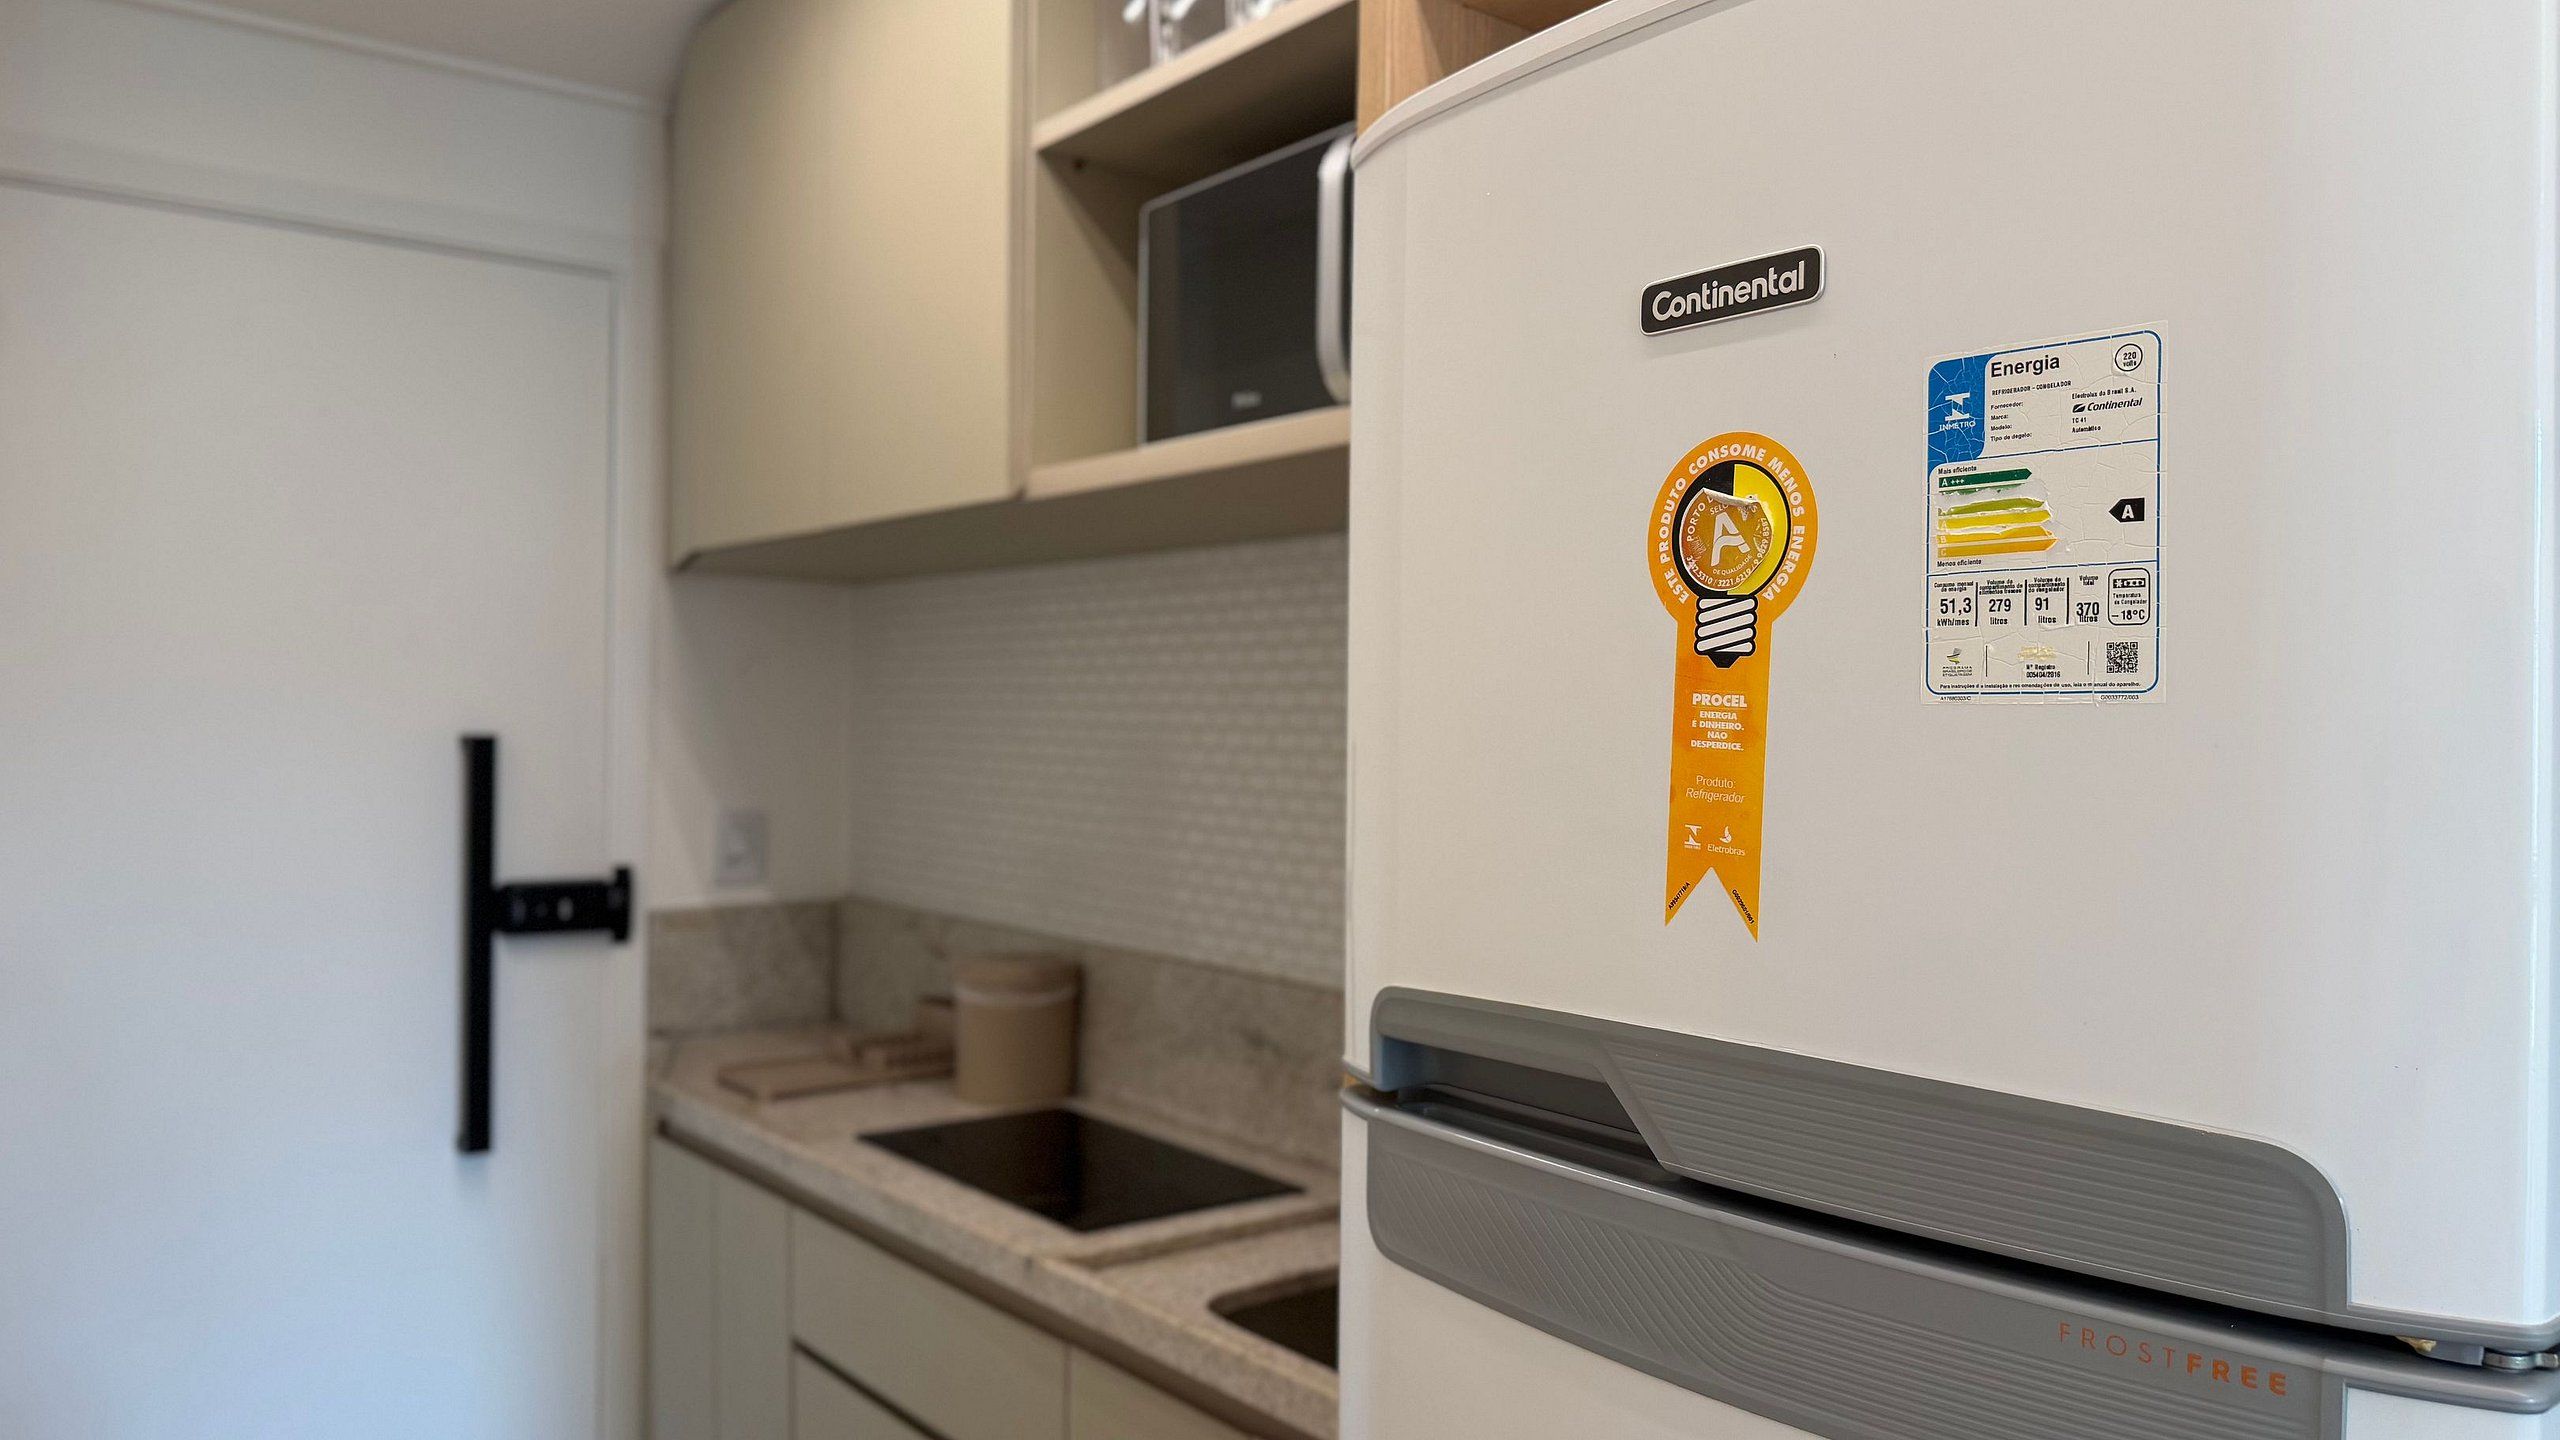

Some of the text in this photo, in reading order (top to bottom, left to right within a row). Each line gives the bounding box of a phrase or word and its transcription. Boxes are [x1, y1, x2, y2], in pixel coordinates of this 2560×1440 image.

[1652, 260, 1804, 321] Continental
[2123, 352, 2136, 360] 220
[1991, 355, 2060, 378] Energia
[1992, 386, 2030, 396] REFRIGERADOR
[2036, 380, 2071, 390] CONGELADOR
[1991, 401, 2024, 410] Fornecedor:
[2088, 397, 2143, 411] Continental
[1940, 421, 1976, 431] INMETRO
[1689, 444, 1766, 475] CONSOME
[1768, 457, 1805, 517] MENOS
[2122, 504, 2134, 519] A
[1660, 478, 1686, 564] PRODUTO
[1687, 502, 1705, 542] PORTO
[1762, 525, 1805, 601] ENERGIA
[1664, 568, 1690, 604] ESTE
[1940, 597, 1971, 616] 51,3
[1989, 599, 2011, 612] 279
[2035, 597, 2049, 611] 91
[2076, 602, 2099, 616] 370
[1692, 693, 1747, 708] PROCEL
[1700, 711, 1737, 720] ENERGIA
[1699, 720, 1744, 730] DINHEIRO.
[1691, 740, 1744, 751] DESPERDICE.
[1696, 775, 1736, 789] Produto:
[1686, 788, 1745, 803] Refrigerador
[1707, 843, 1745, 856] Eletrobras
